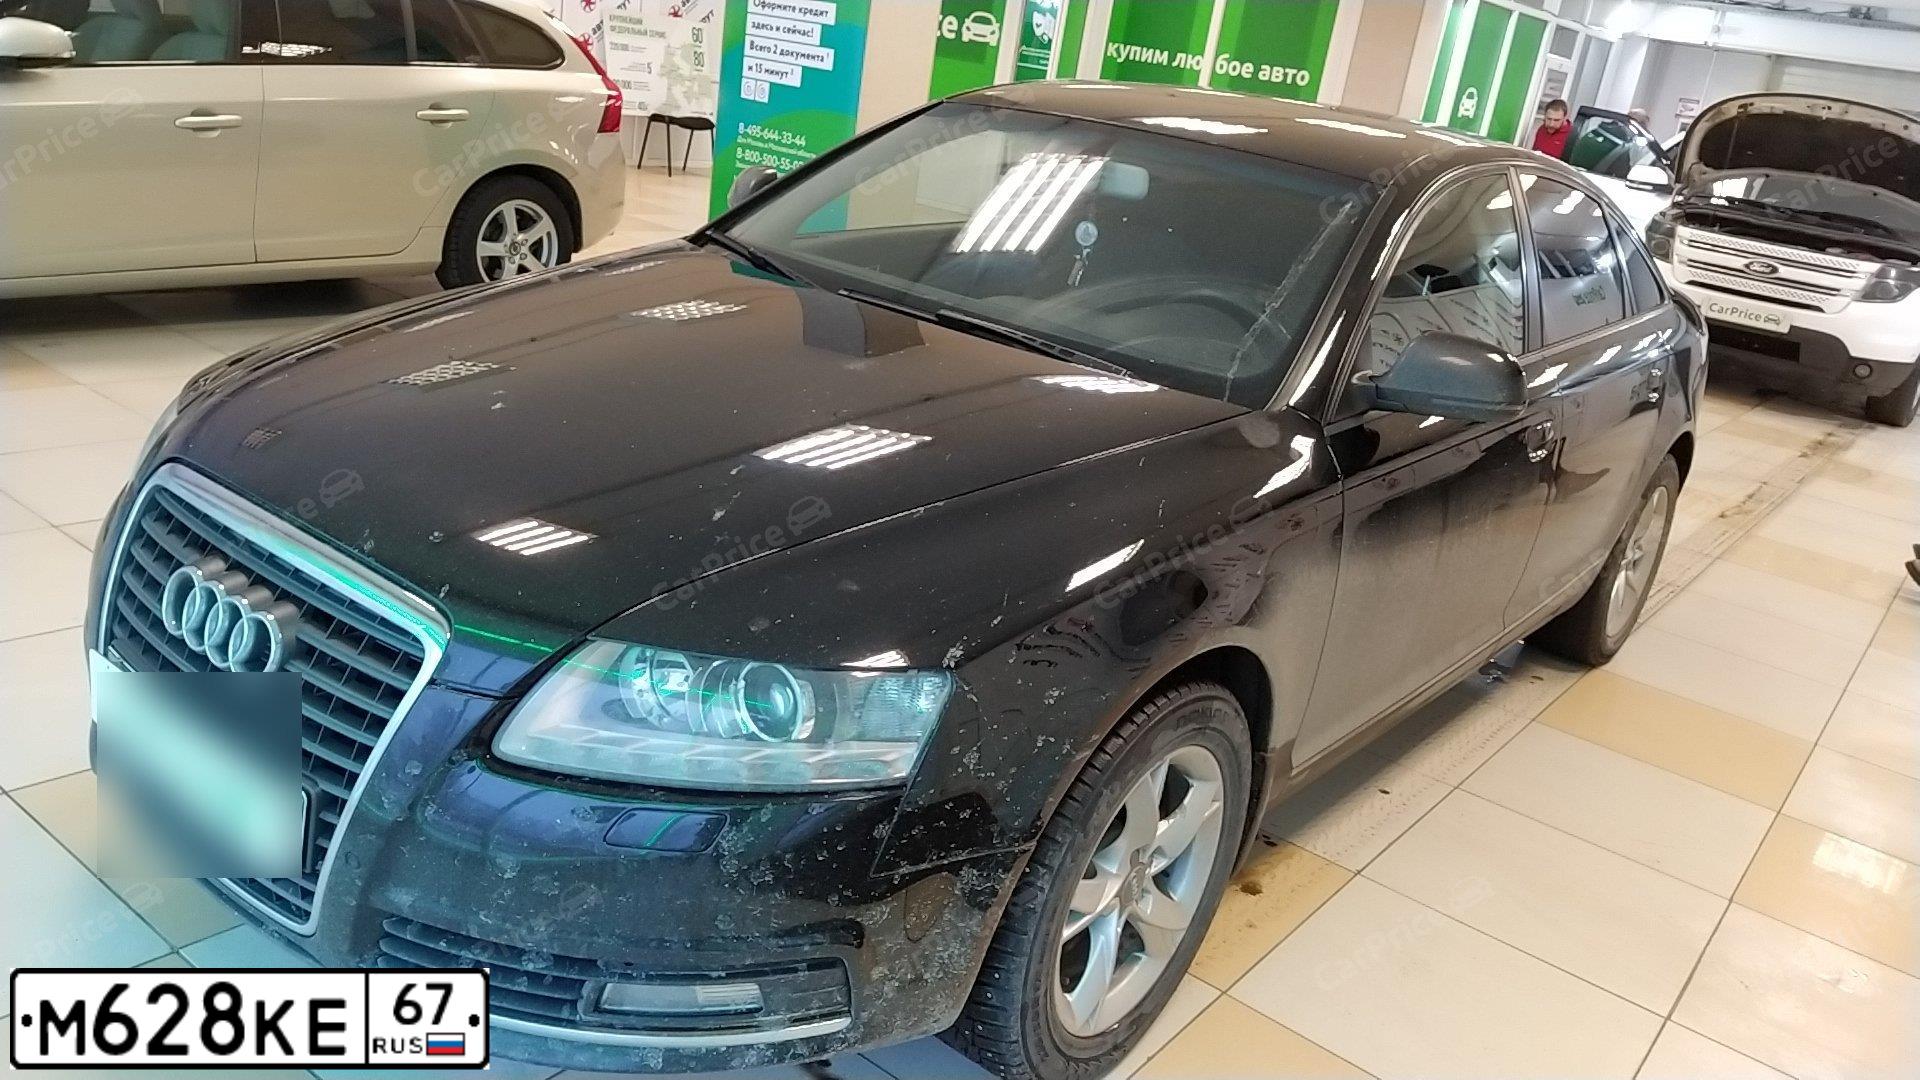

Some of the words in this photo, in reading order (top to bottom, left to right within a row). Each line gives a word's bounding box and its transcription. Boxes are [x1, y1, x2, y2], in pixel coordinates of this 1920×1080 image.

[798, 6, 829, 18] кредит
[751, 21, 774, 32] здесь
[782, 25, 815, 38] сейчас!
[749, 40, 772, 54] Всего
[772, 44, 779, 55] 2
[779, 48, 825, 63] документа
[754, 62, 763, 74] 15
[764, 66, 789, 80] минут
[1106, 41, 1169, 66] купим
[1257, 64, 1311, 87] авто
[1709, 302, 1762, 322] CarPrice
